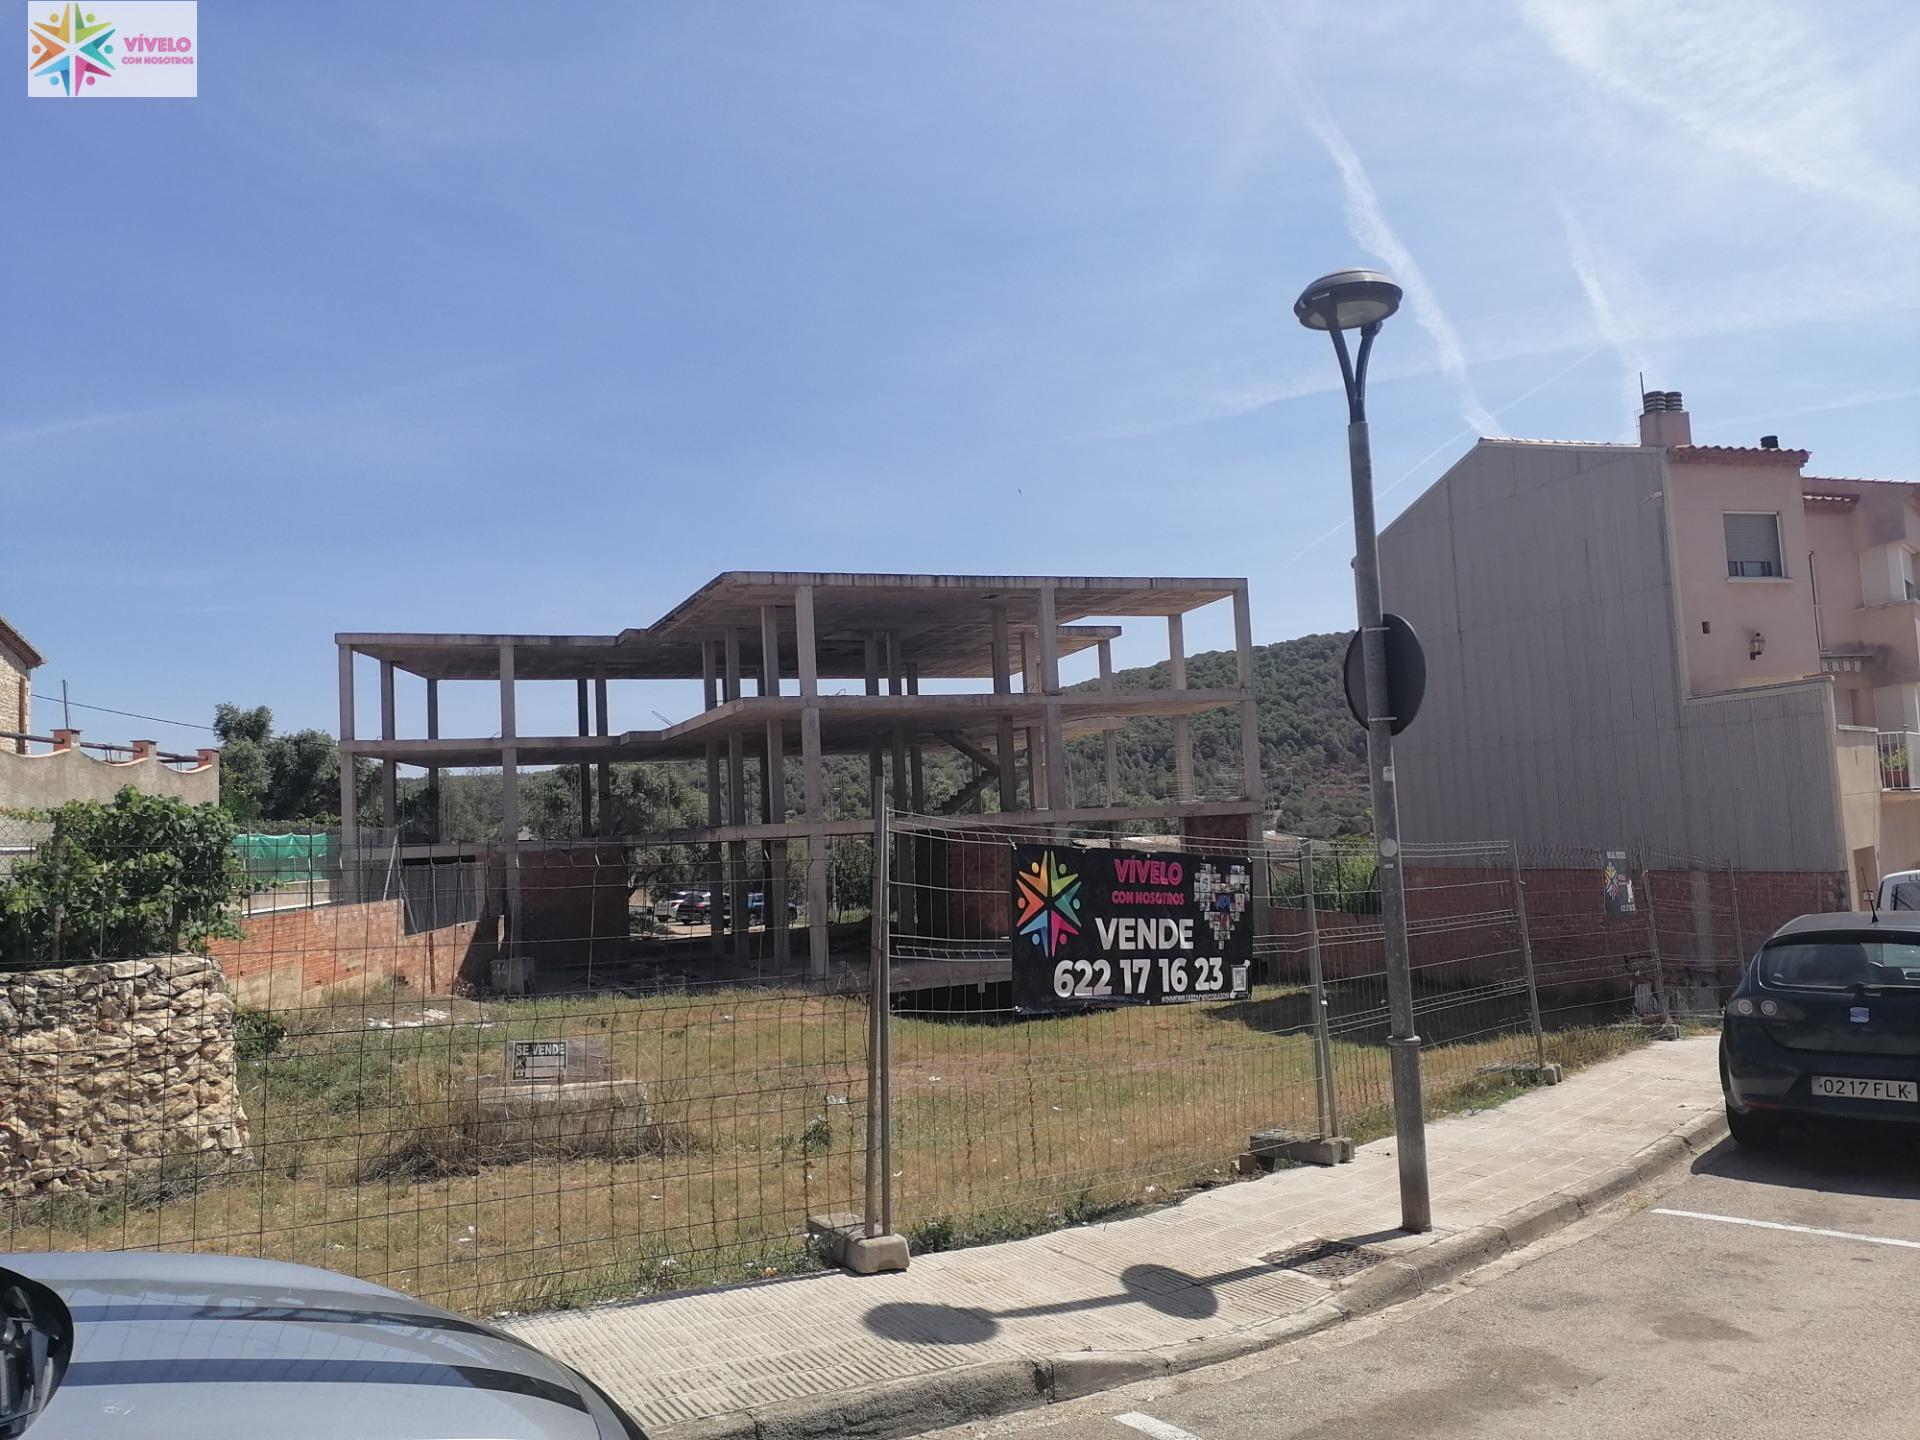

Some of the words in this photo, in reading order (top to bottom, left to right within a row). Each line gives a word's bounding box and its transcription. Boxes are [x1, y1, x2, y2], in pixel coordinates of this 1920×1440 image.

[1111, 890, 1134, 904] CON
[1135, 891, 1185, 906] NOSOTROS
[1095, 917, 1194, 950] VENDE
[1053, 958, 1112, 998] 622
[1119, 958, 1151, 994] 17
[1158, 957, 1188, 992] 16
[1194, 957, 1224, 991] 23
[516, 1044, 530, 1056] SE
[533, 1043, 566, 1056] VENDE
[1823, 1079, 1869, 1096] 0217
[1873, 1082, 1909, 1099] FLK
